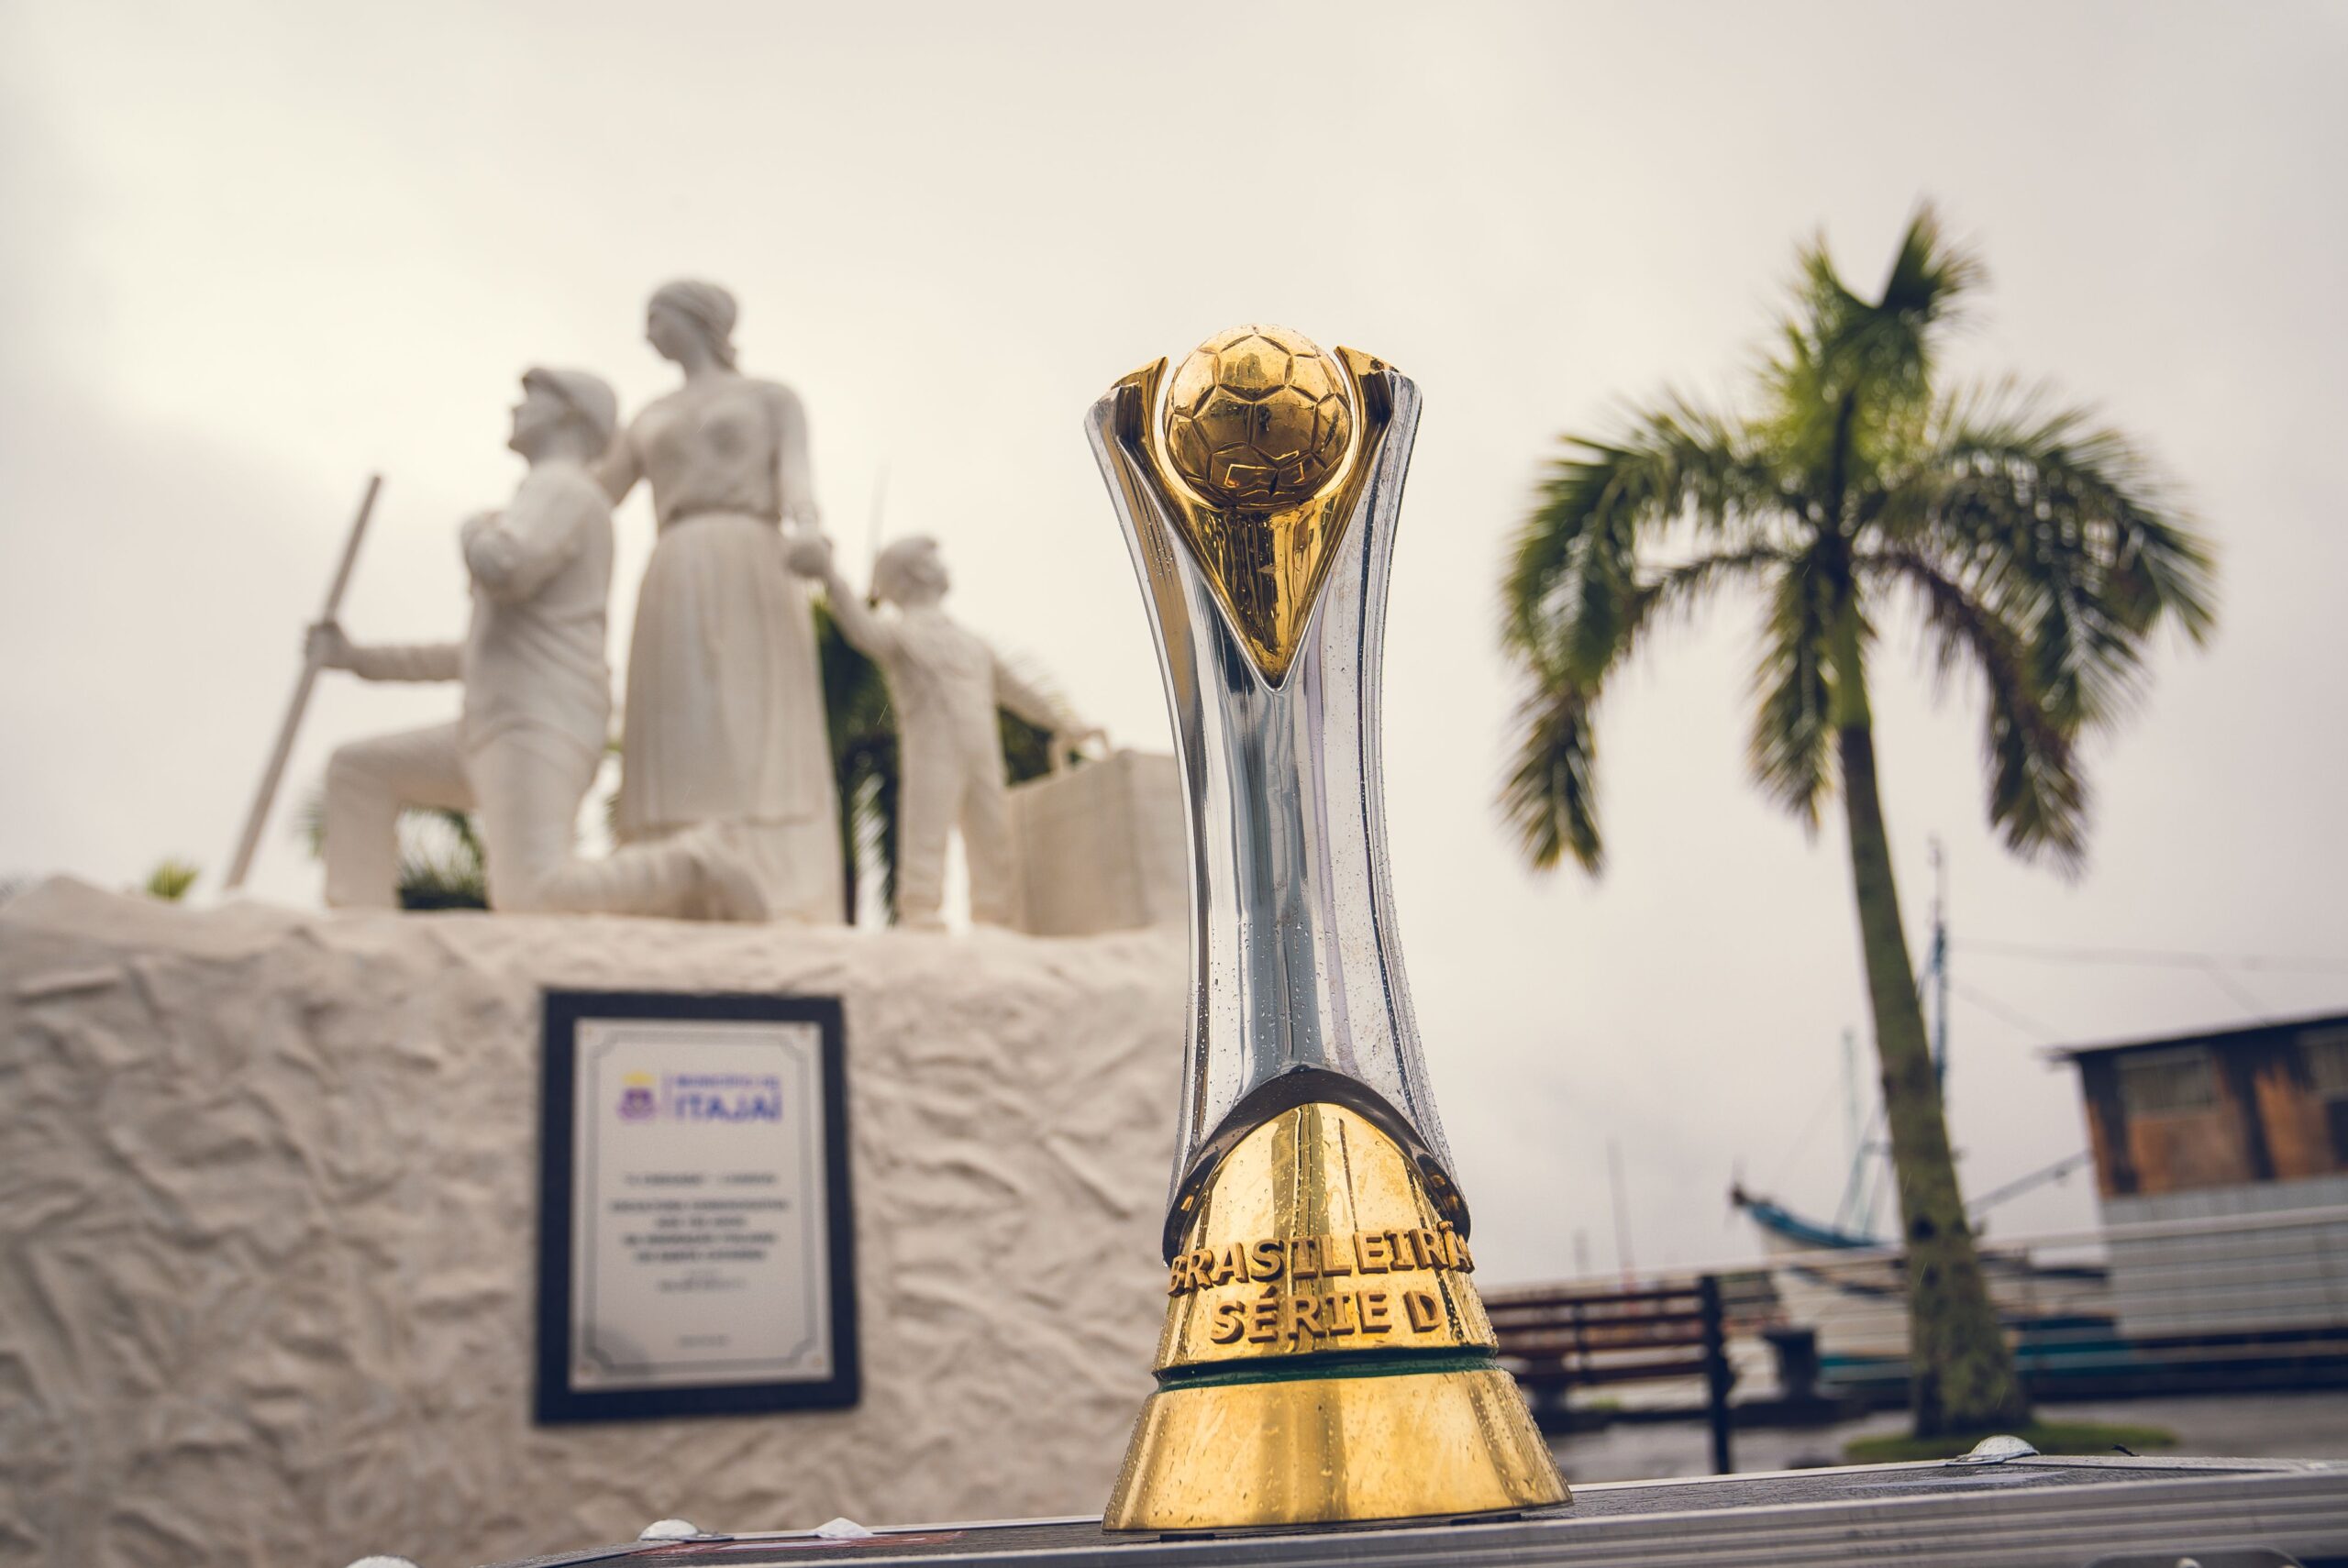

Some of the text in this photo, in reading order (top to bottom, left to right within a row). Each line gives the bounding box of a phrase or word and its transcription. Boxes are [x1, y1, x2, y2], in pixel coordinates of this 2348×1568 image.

[1168, 1221, 1475, 1297] BRASILEIRÃ
[1210, 1286, 1442, 1344] SÉRIE D
